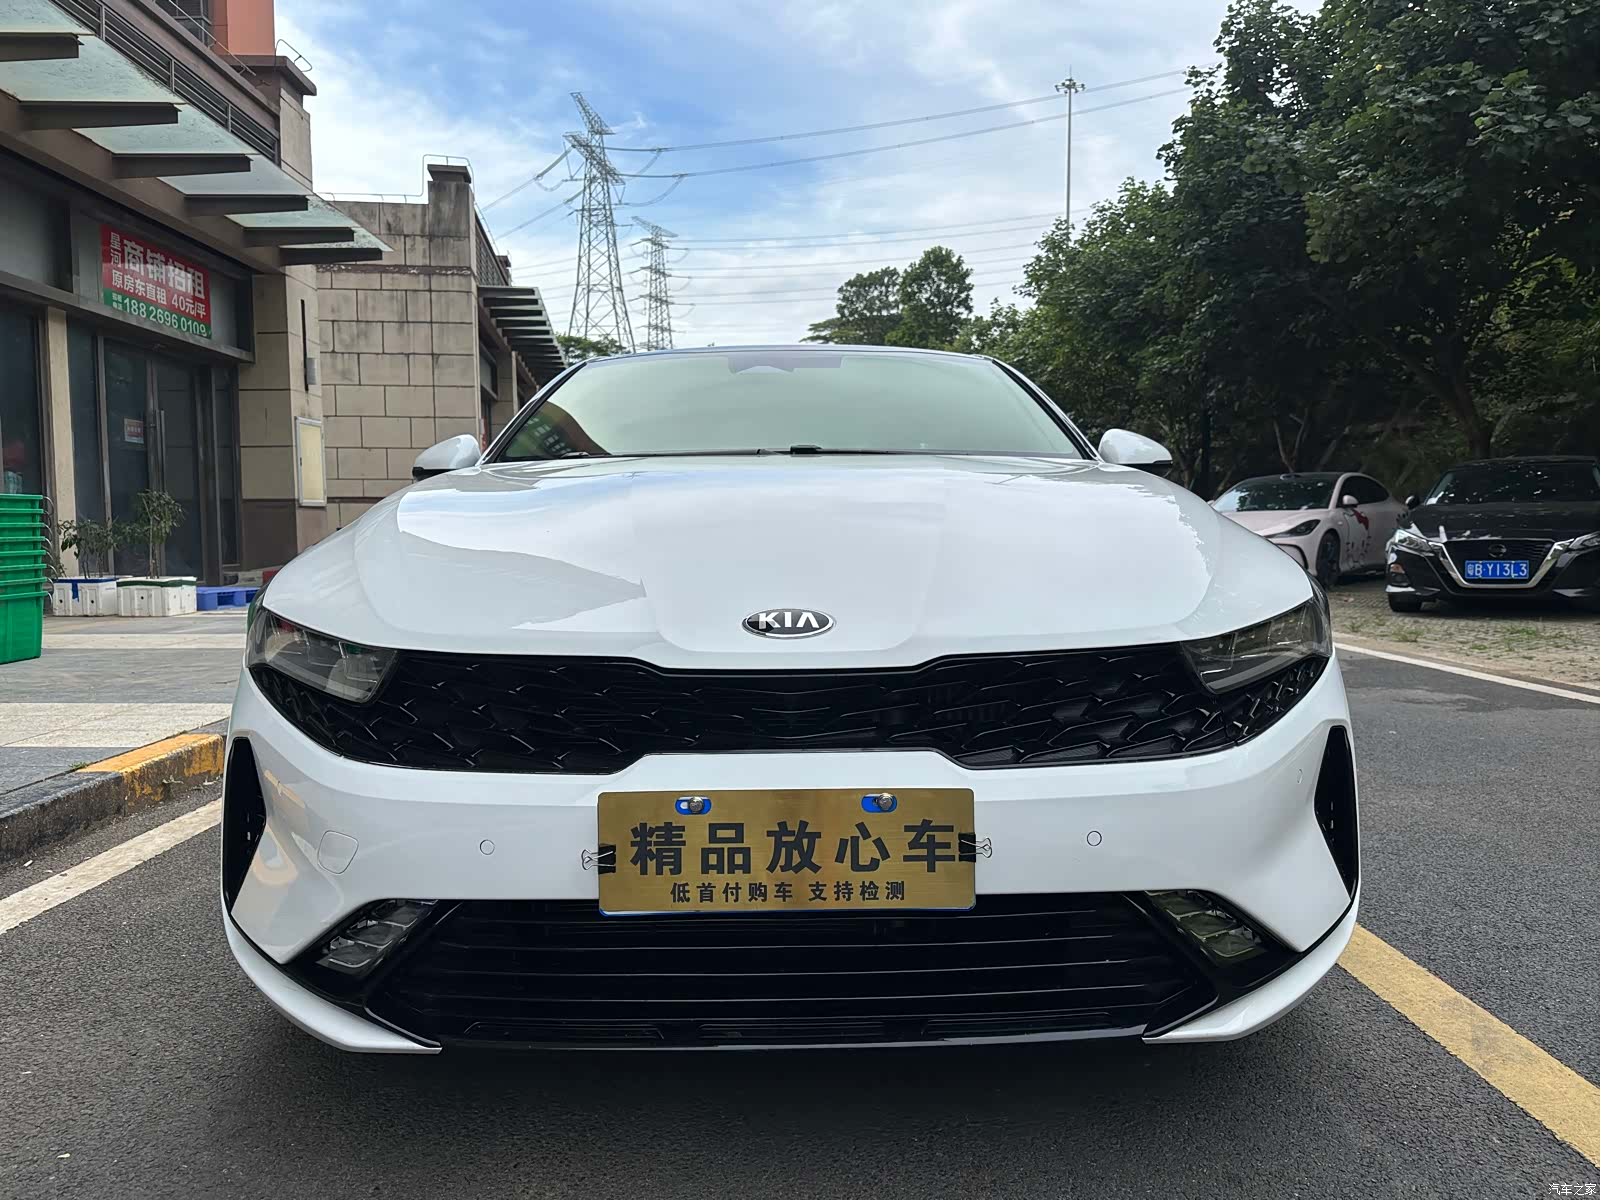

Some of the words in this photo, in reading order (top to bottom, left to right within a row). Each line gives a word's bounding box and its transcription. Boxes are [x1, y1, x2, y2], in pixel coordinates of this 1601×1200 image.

[110, 231, 121, 268] 星河
[123, 239, 206, 300] 商铺招租
[112, 269, 168, 306] 原房东直租
[171, 294, 206, 319] 40元/平
[123, 297, 147, 318] 188
[149, 306, 178, 328] 2696
[758, 611, 820, 630] KIA
[629, 818, 956, 876] 精品放心车
[670, 881, 794, 903] 低首付购车
[808, 881, 906, 902] 支持检测
